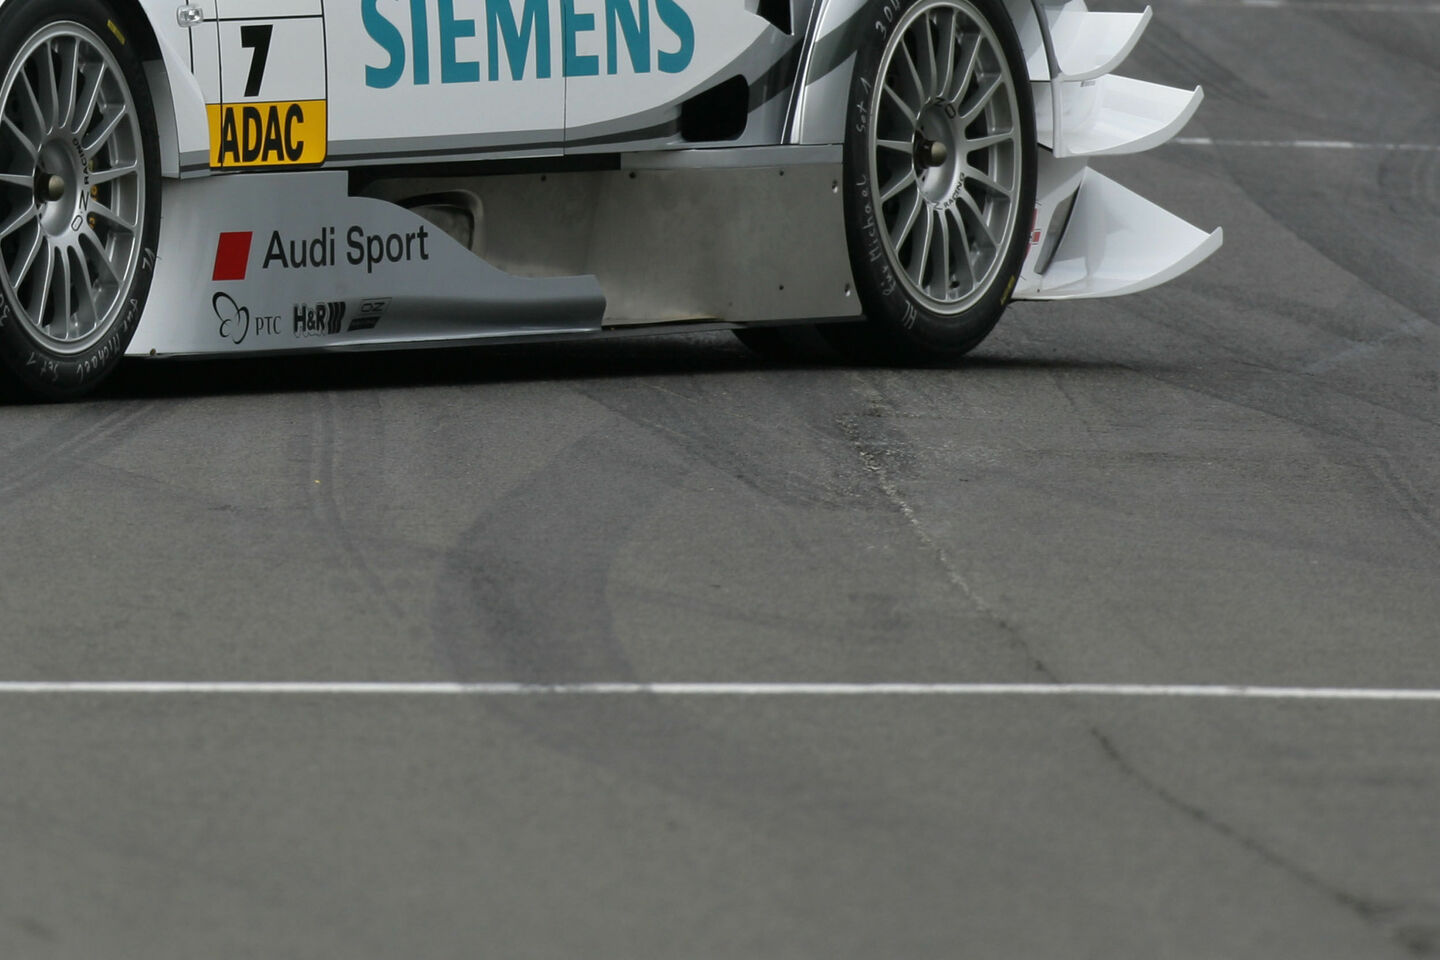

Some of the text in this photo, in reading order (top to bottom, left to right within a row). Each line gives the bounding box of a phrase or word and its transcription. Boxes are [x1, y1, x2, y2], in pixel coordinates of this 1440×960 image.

[240, 24, 273, 97] 7
[217, 103, 304, 163] ADAC
[262, 225, 429, 274] Audi Sport
[255, 315, 281, 335] PTC
[293, 303, 326, 333] H&R
